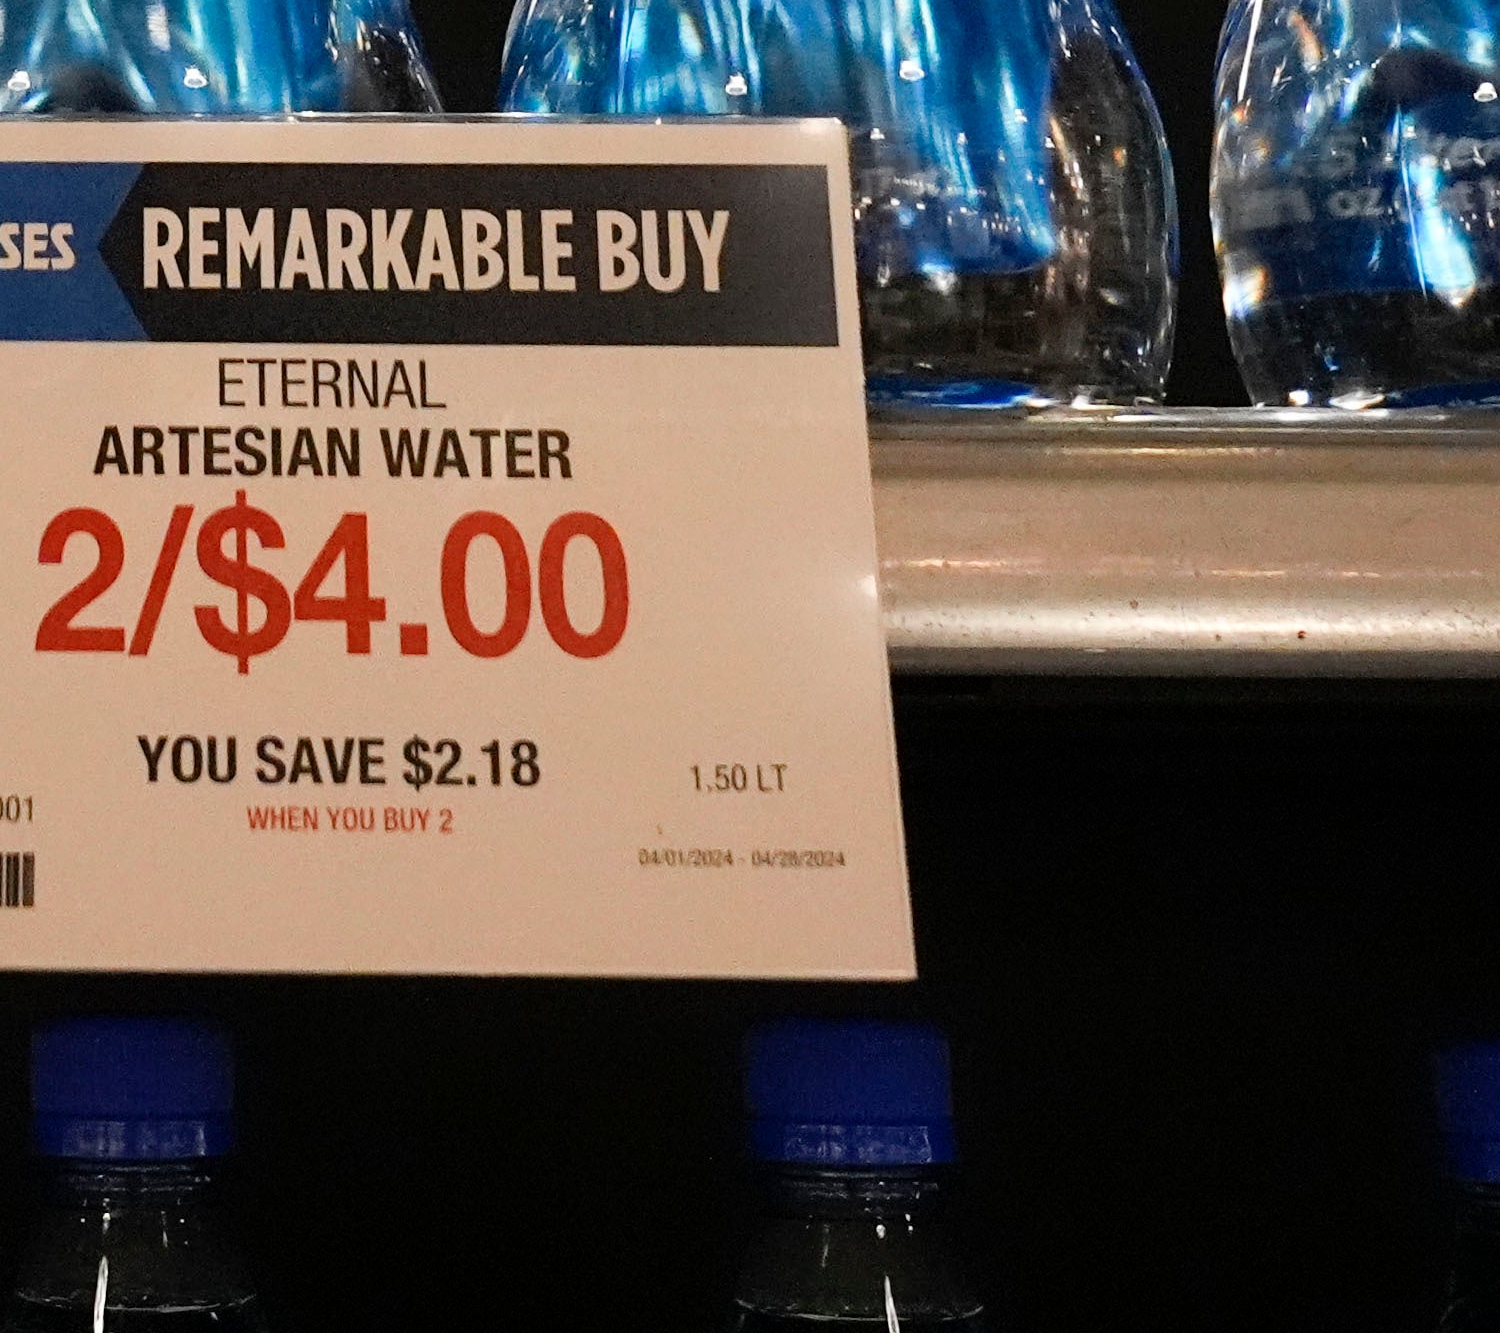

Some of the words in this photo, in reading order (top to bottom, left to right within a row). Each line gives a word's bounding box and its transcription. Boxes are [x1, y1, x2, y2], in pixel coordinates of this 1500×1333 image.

[142, 207, 576, 292] REMARKABLE
[597, 209, 731, 293] BUY
[217, 357, 447, 410] ETERNAL
[93, 424, 361, 477] ARTESIAN
[382, 427, 573, 480] WATER
[34, 489, 630, 676] 2/$4.00
[137, 734, 237, 784] YOU
[255, 735, 387, 786] SAVE
[401, 734, 541, 792] $2.18
[690, 763, 748, 793] 1.50
[756, 763, 788, 793] LT
[247, 804, 320, 831] WHEN
[326, 805, 375, 832] YOU
[384, 805, 431, 833] BUY
[439, 808, 454, 834] 2
